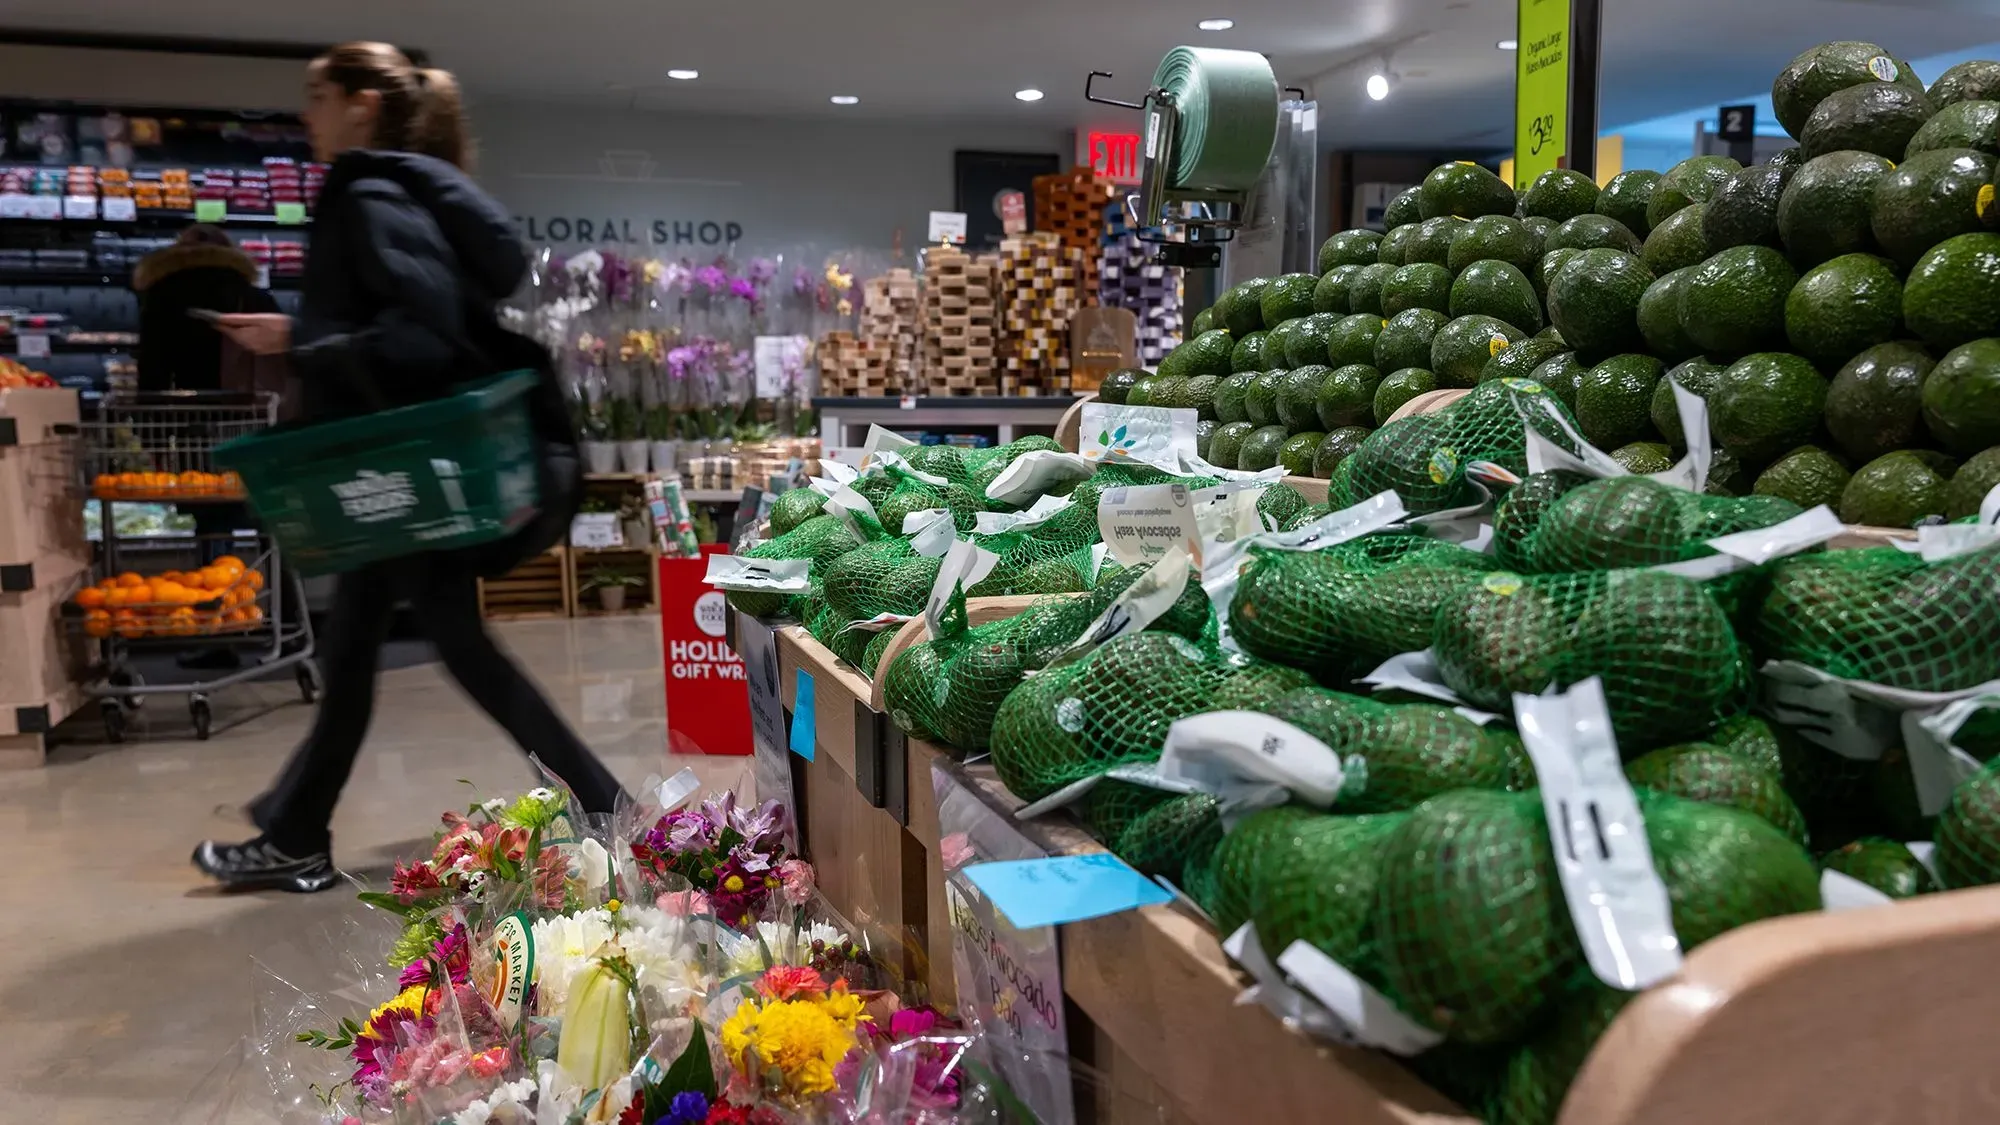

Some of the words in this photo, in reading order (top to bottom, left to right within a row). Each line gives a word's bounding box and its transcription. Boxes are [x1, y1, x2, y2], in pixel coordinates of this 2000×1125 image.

[1726, 110, 1743, 133] 2
[1088, 132, 1141, 177] EXIT
[652, 220, 742, 245] SHOP
[672, 663, 712, 679] GIFT
[715, 664, 747, 681] WR
[507, 941, 522, 1006] MARKET
[990, 930, 1057, 1030] Avocado
